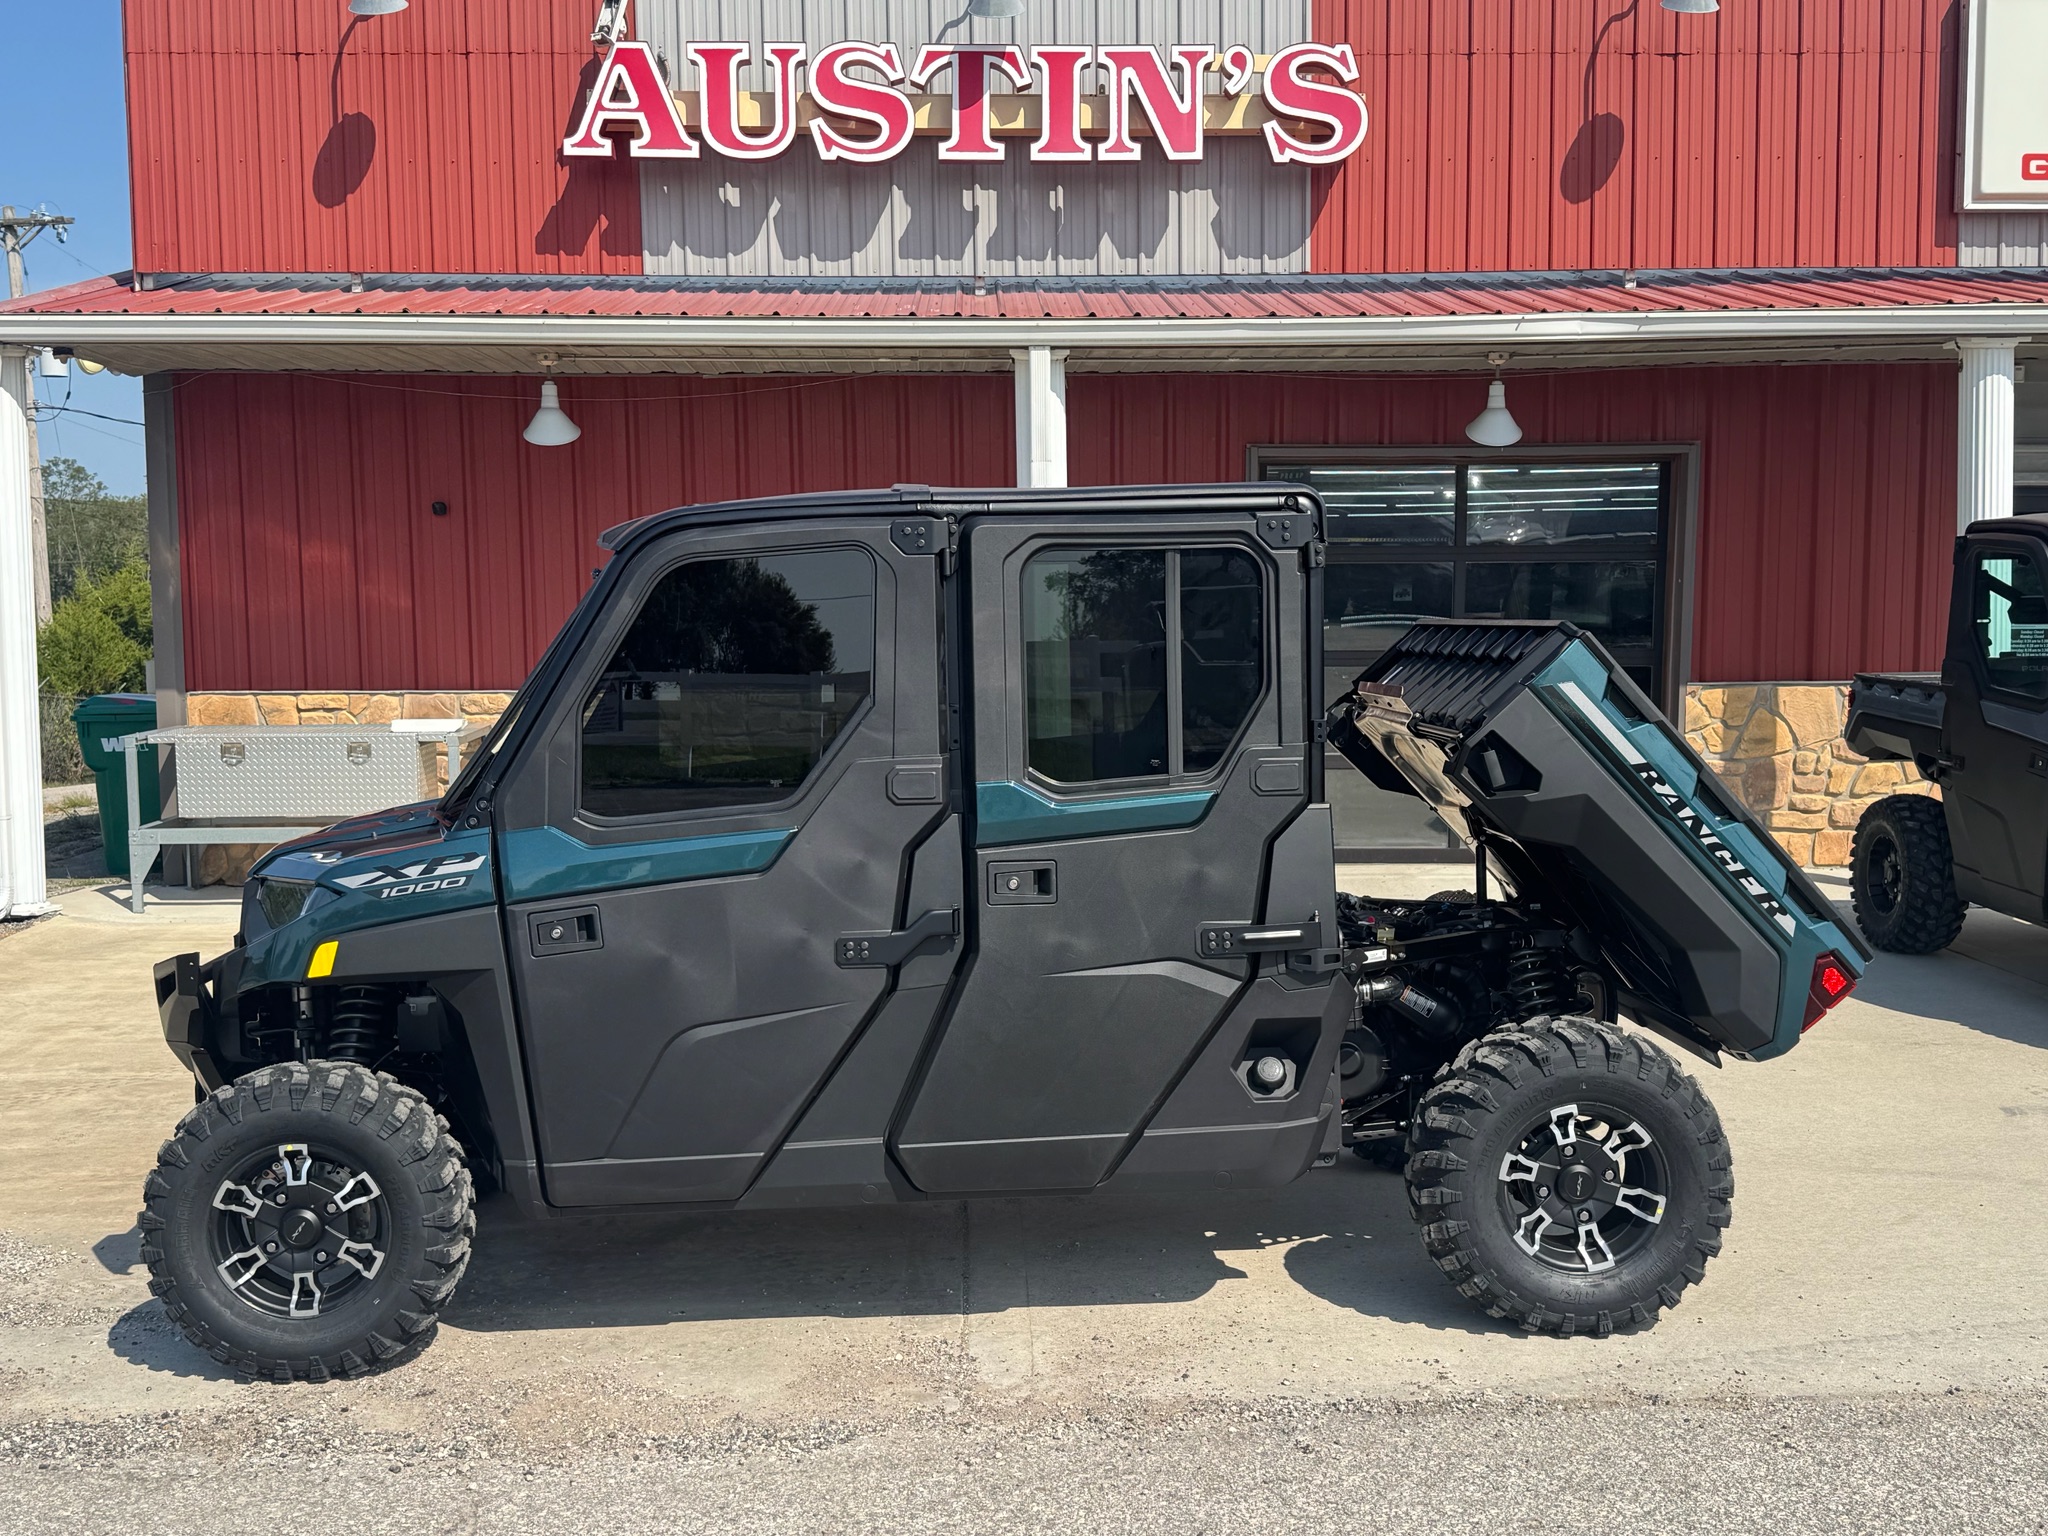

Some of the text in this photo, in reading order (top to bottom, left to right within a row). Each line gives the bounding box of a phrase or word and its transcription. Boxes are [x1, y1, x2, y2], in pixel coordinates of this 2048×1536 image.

[563, 40, 1369, 165] AUSTIN'S
[357, 852, 481, 887] XP
[1632, 762, 1790, 920] RANGER
[380, 876, 467, 899] 1000
